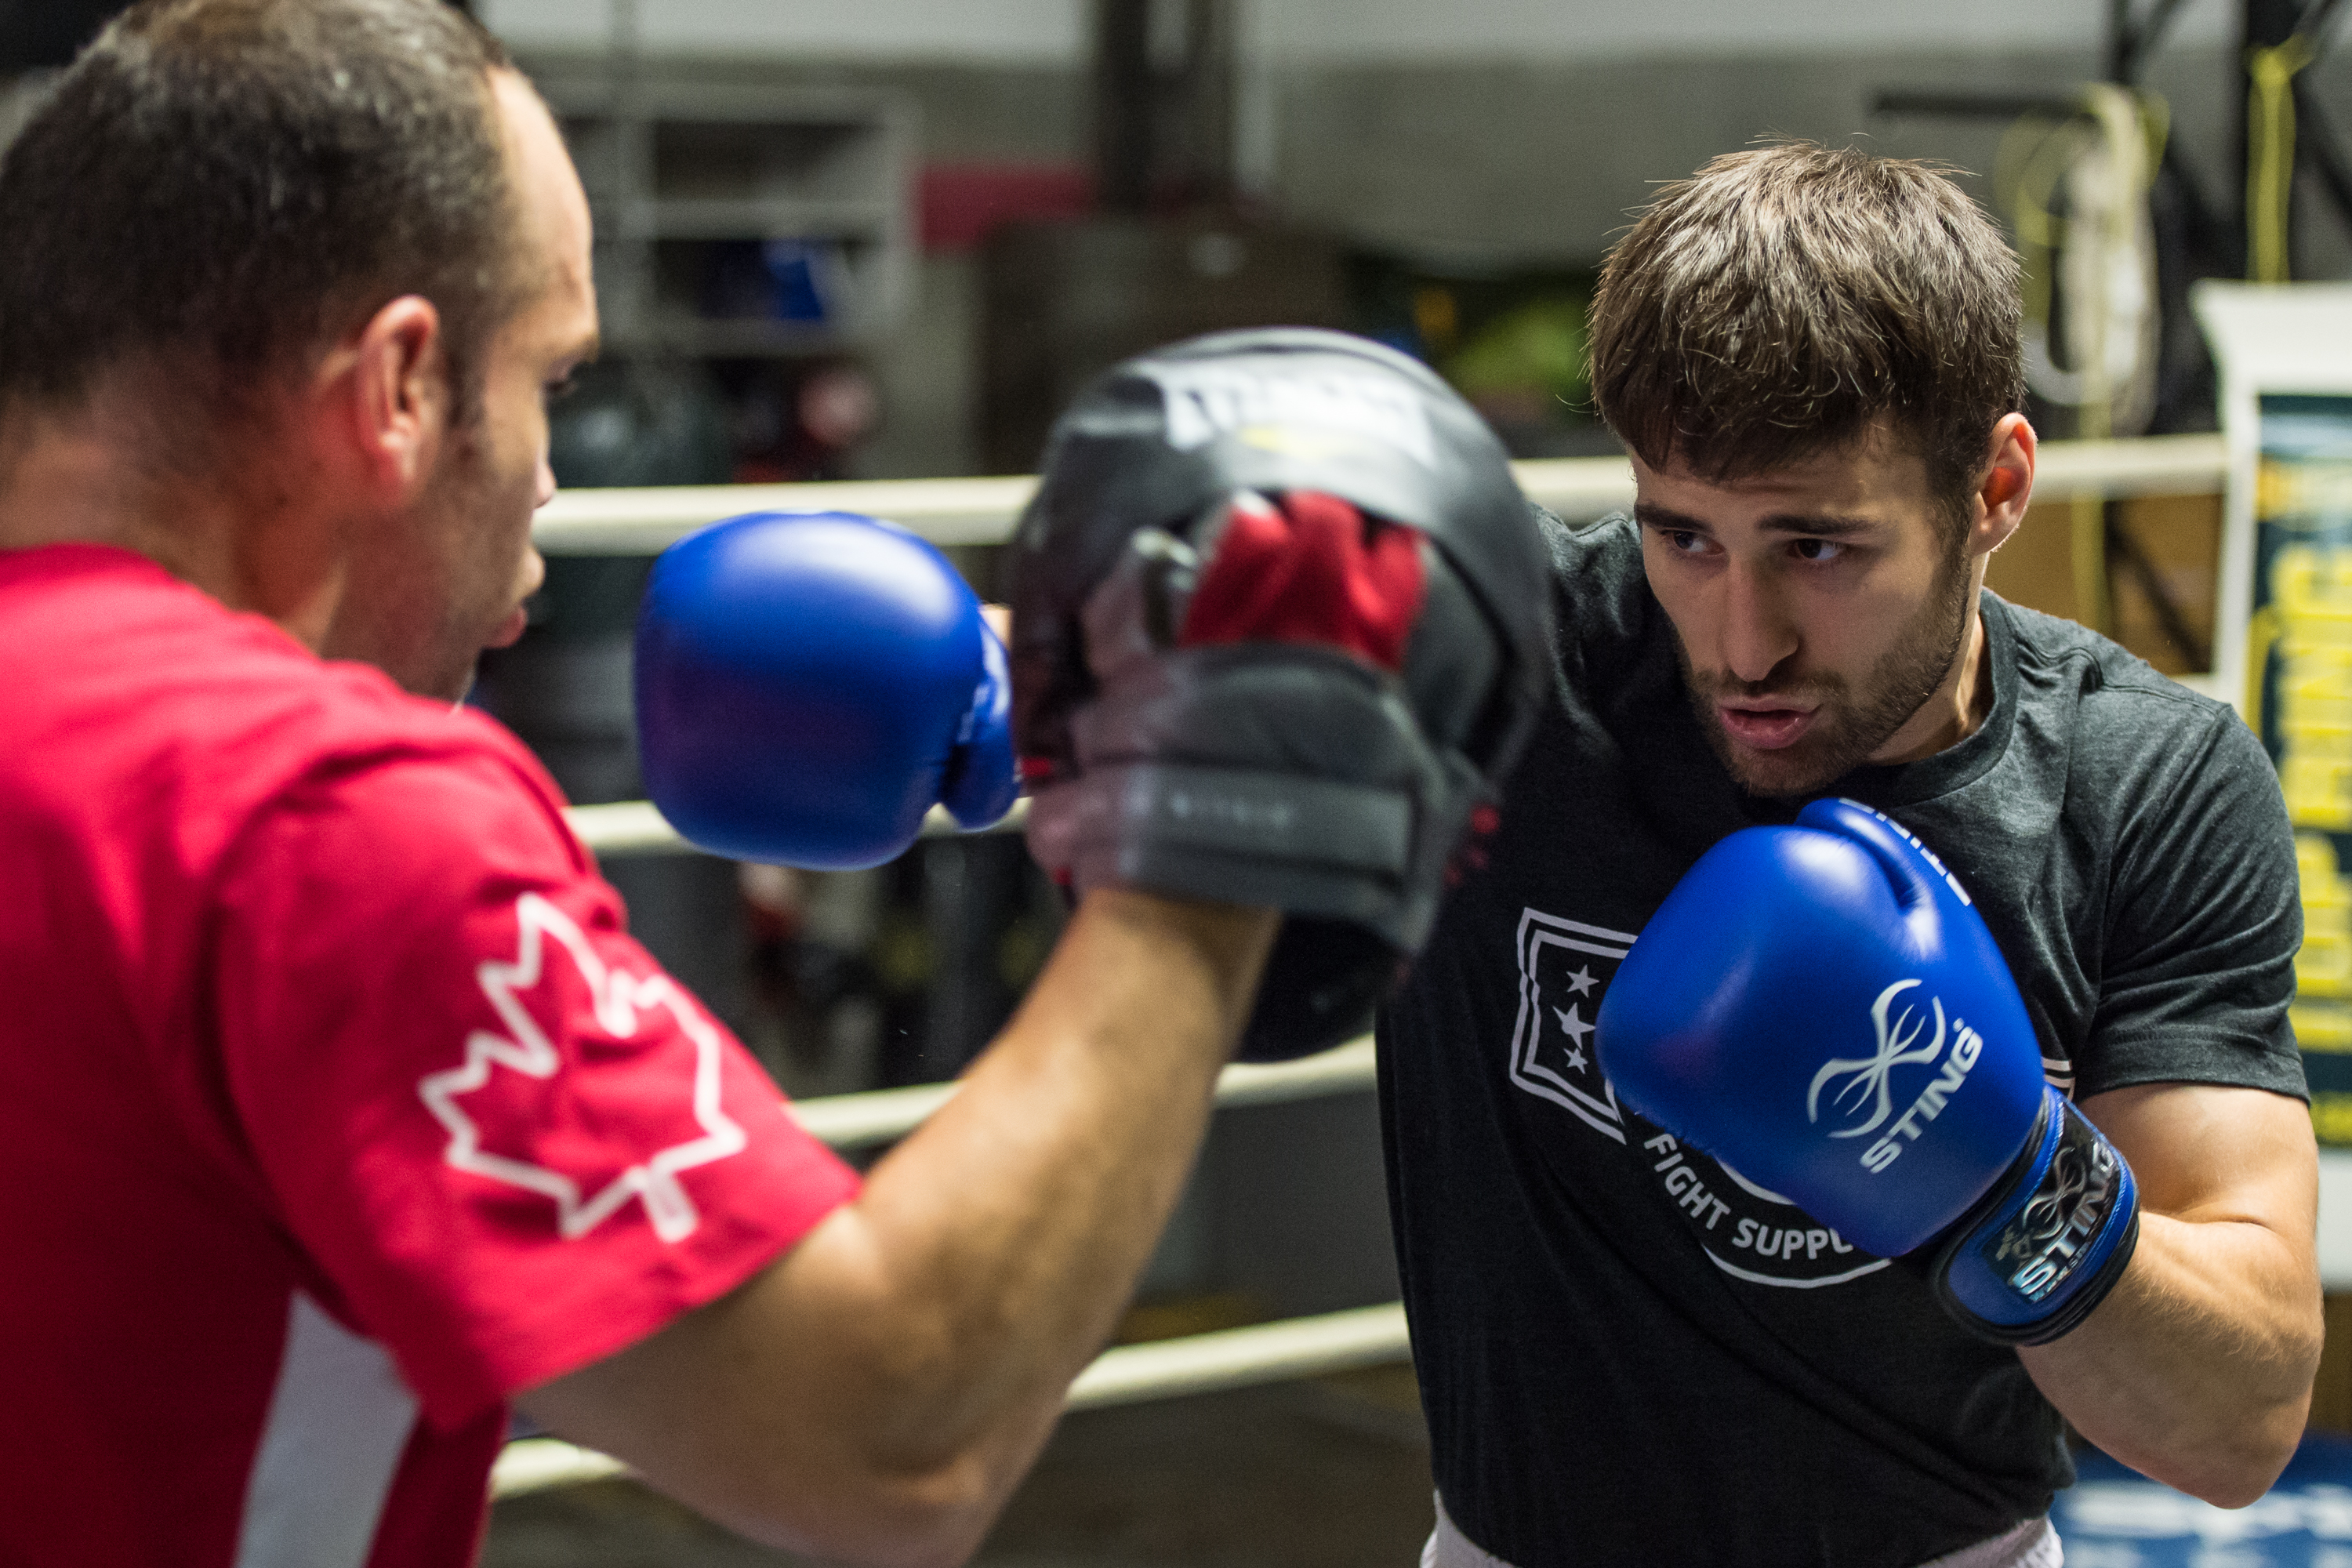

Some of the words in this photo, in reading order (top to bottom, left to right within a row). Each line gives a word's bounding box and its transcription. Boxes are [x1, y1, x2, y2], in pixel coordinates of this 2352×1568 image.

[1860, 1025, 1984, 1174] STING
[1643, 1133, 1731, 1230] FIGHT
[1731, 1218, 1853, 1260] SUPPL
[2012, 1141, 2115, 1295] STING
